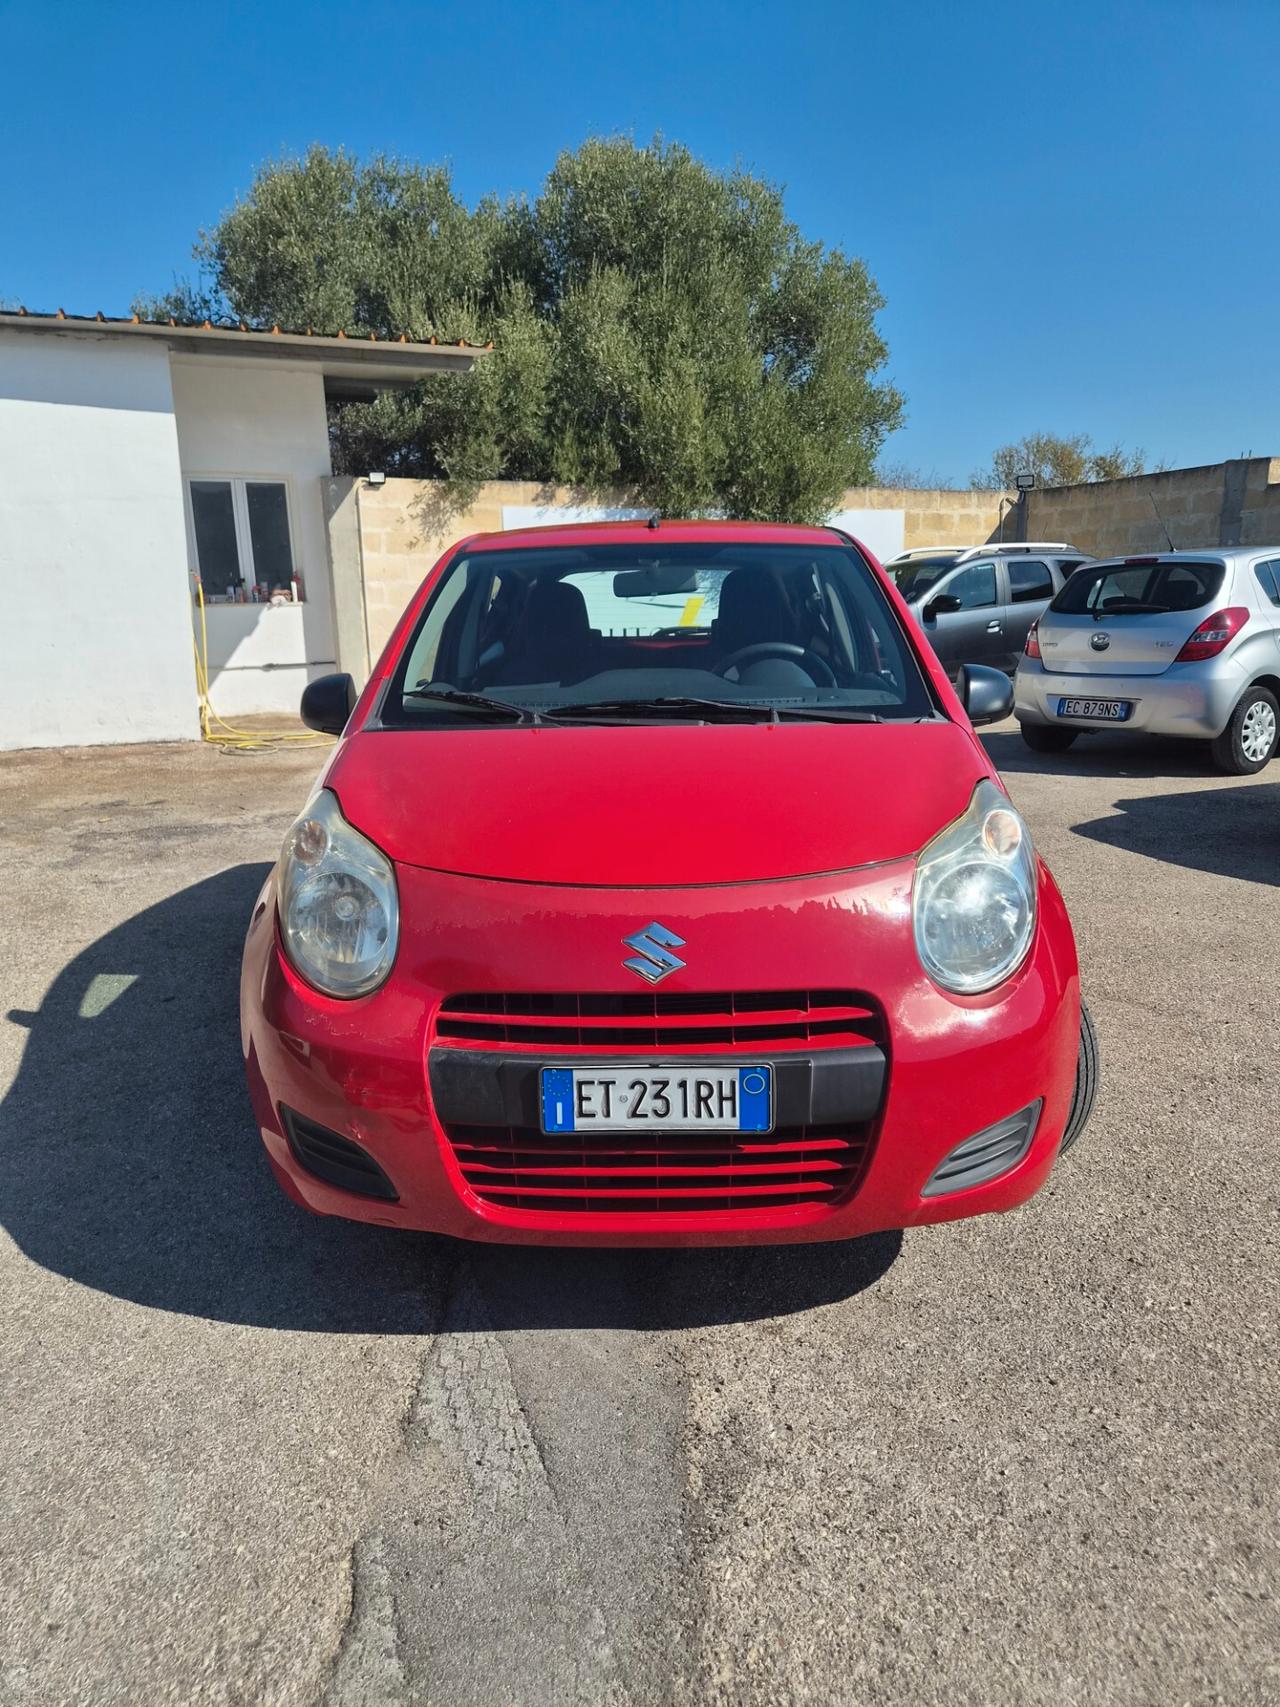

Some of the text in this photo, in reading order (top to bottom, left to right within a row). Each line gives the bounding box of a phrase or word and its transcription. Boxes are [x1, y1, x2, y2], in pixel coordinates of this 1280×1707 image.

[1065, 700, 1080, 714] EC
[1083, 702, 1119, 717] 879NS
[576, 1080, 737, 1118] ET 231RH
